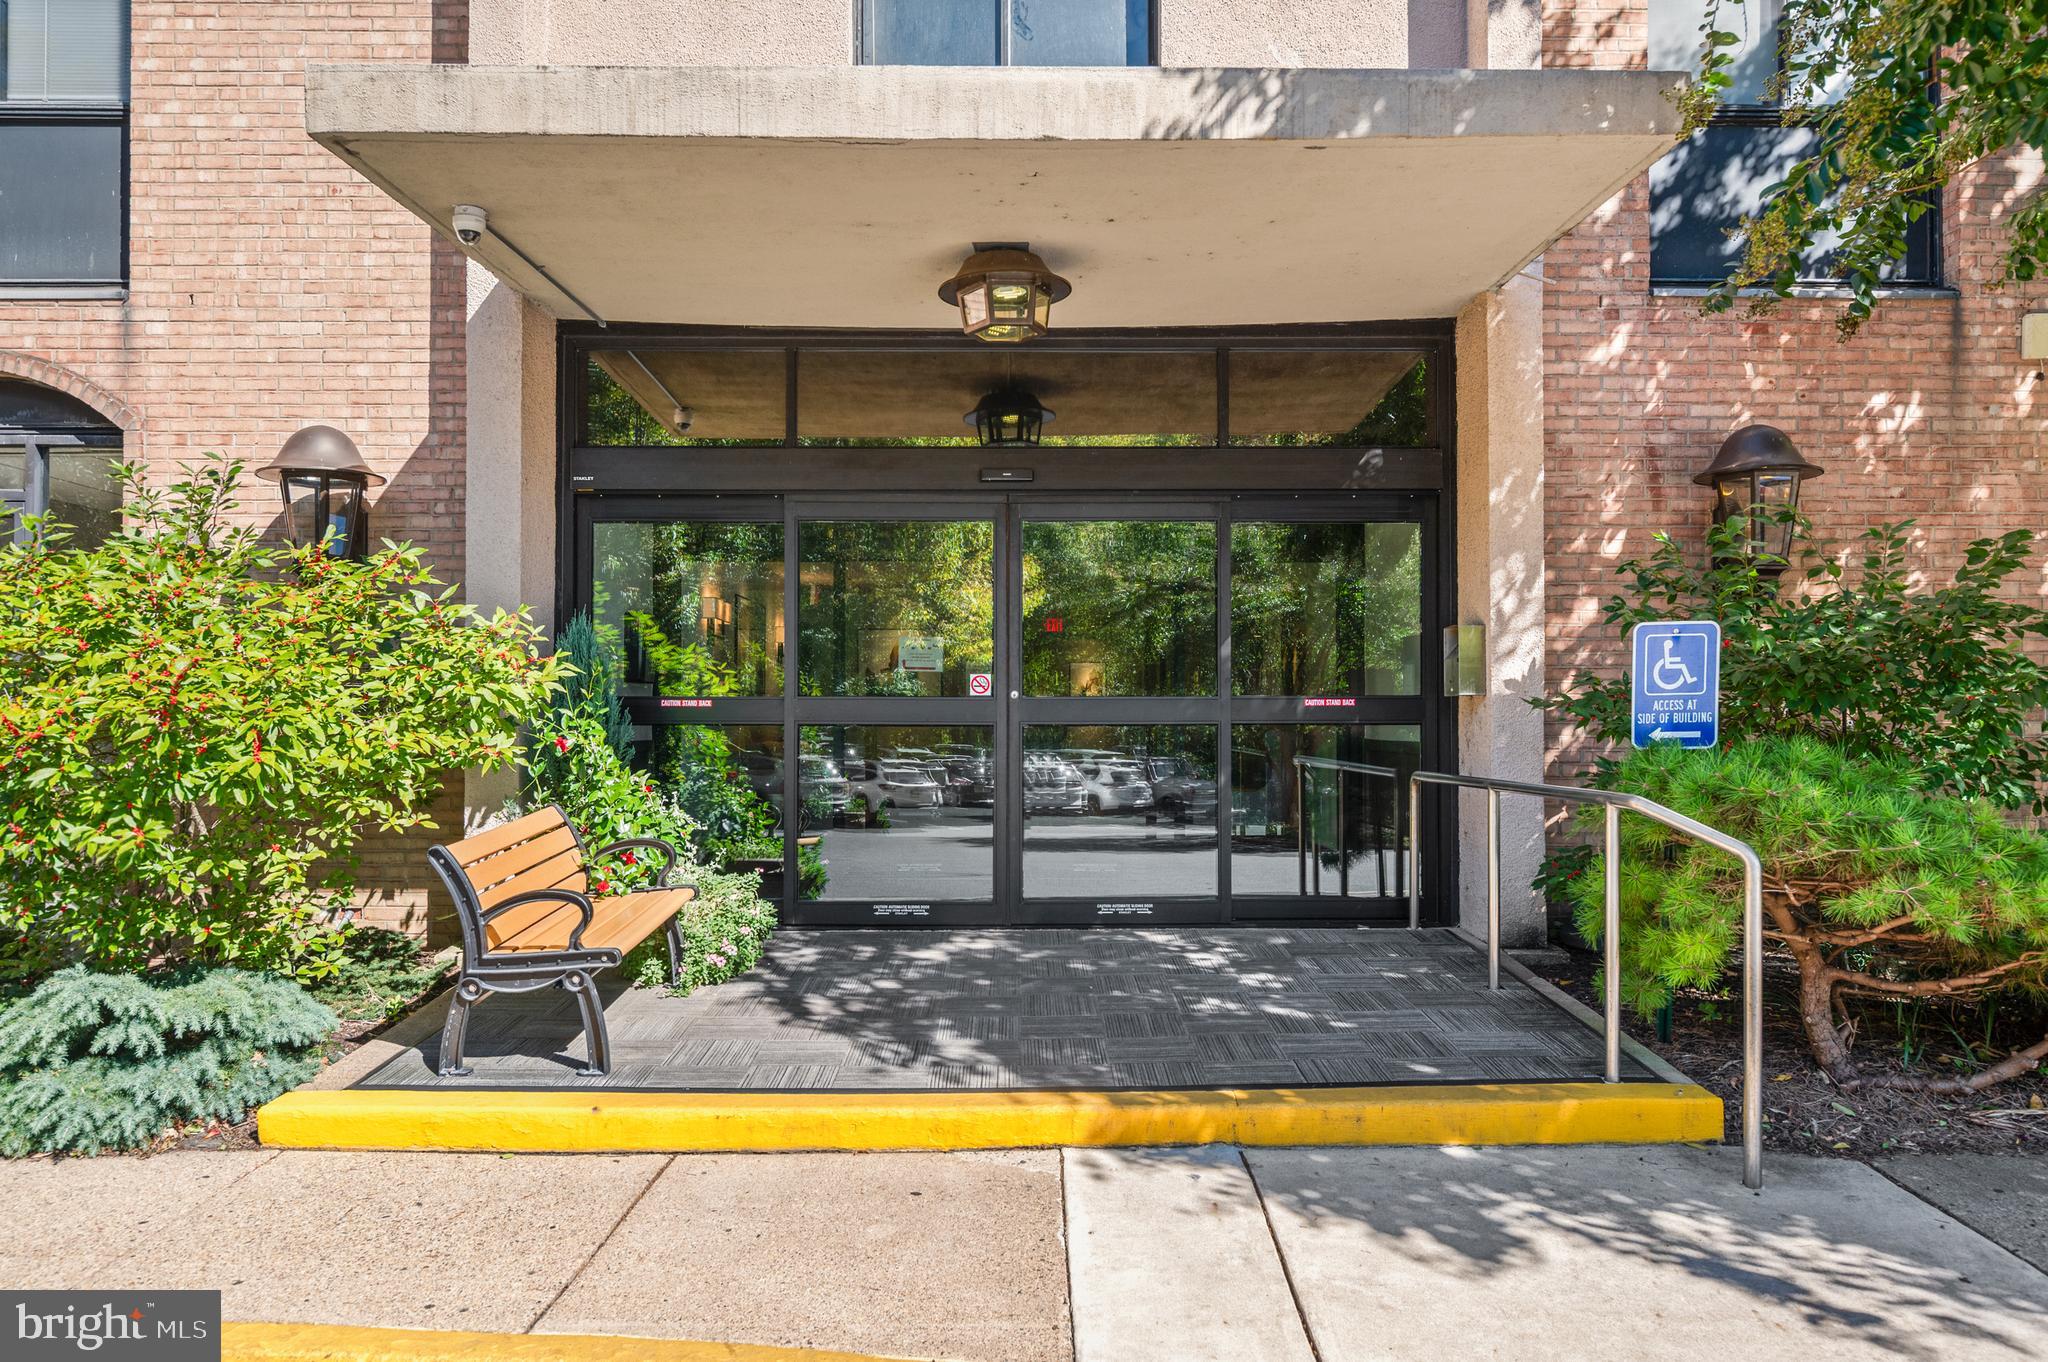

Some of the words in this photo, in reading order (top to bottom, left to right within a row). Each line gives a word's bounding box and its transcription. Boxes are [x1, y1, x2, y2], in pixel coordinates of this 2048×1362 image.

[1046, 617, 1063, 632] EXIT
[661, 699, 681, 707] CAUTION
[682, 699, 698, 707] STAND
[699, 699, 712, 707] BACK
[1304, 698, 1325, 706] CAUTION
[1326, 698, 1341, 706] STAND
[1342, 698, 1355, 706] BACK
[1653, 700, 1684, 711] ACCESS
[1687, 699, 1698, 710] AT
[1637, 713, 1656, 724] SIDE
[1659, 712, 1671, 723] OF
[1673, 712, 1713, 723] BUILDING
